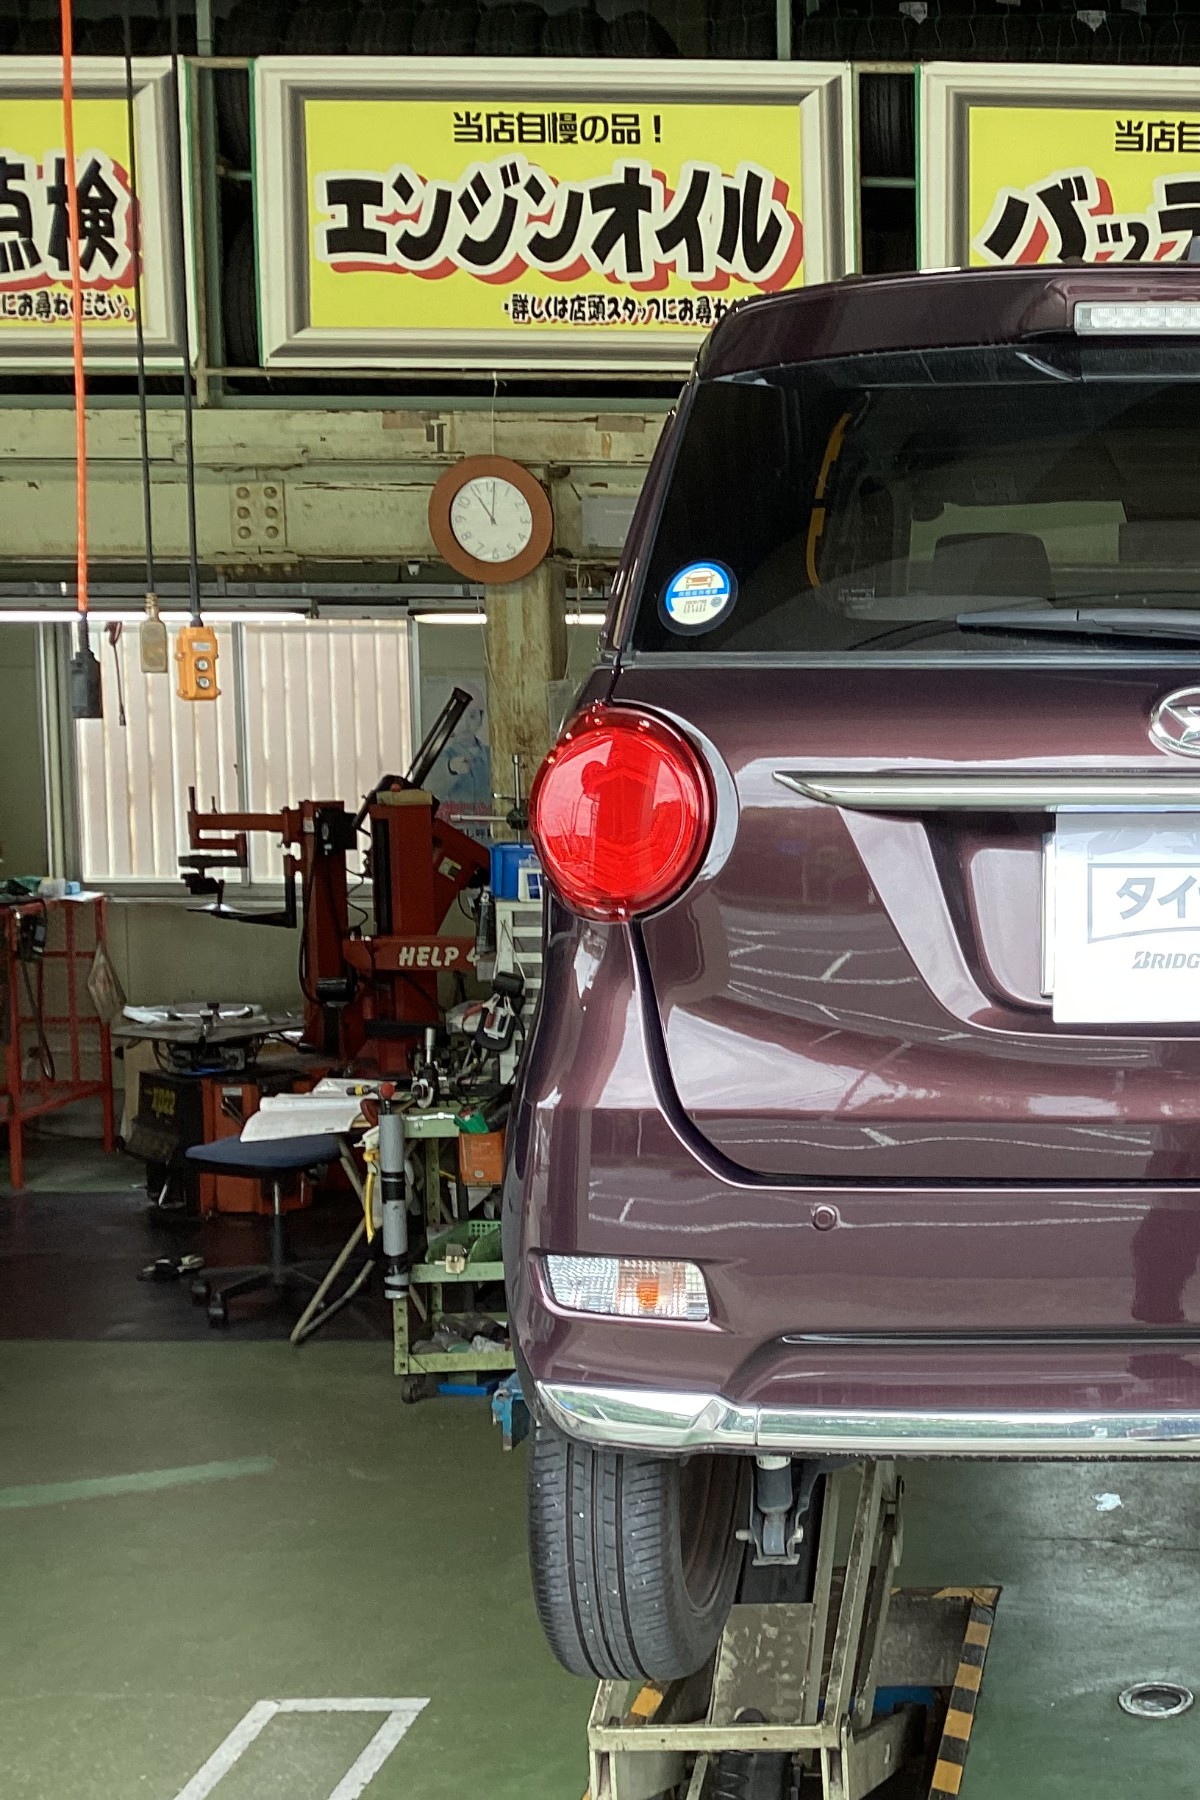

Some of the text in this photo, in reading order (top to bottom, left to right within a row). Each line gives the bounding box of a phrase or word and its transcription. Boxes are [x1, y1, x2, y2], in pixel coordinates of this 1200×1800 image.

[453, 111, 661, 145] 当店自慢の品！
[326, 162, 783, 274] エンジンオイル
[399, 946, 460, 967] HELP
